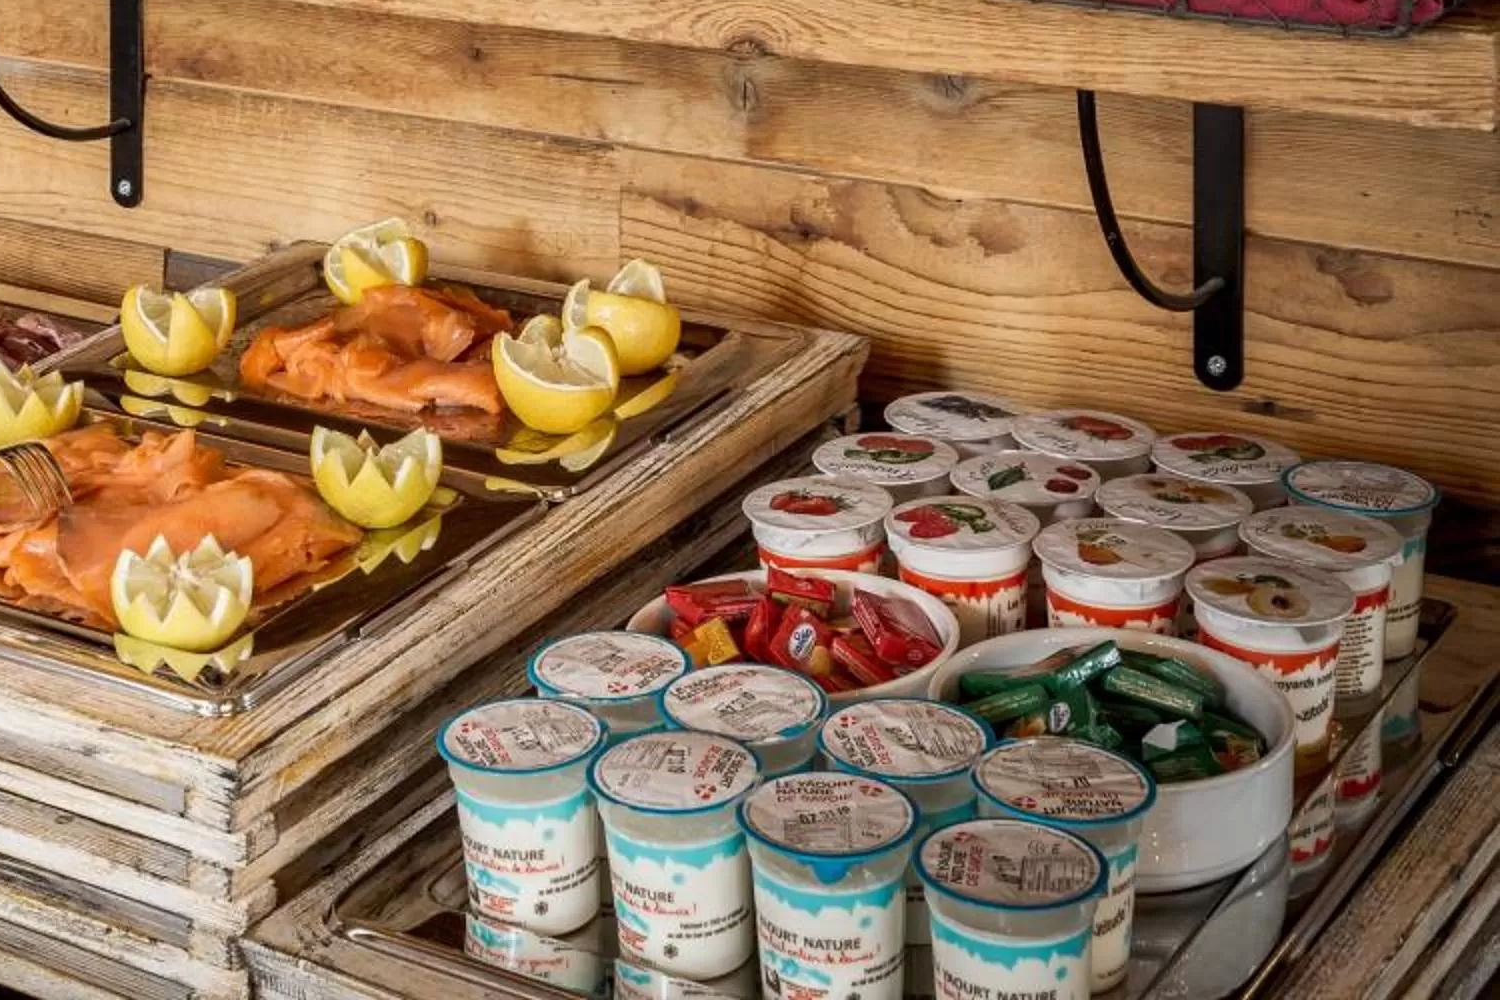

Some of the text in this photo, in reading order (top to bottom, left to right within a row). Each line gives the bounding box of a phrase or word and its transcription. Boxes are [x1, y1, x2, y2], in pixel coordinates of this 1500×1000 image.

[493, 848, 546, 861] NATURE
[625, 881, 675, 903] NATURE
[803, 937, 862, 951] NATURE
